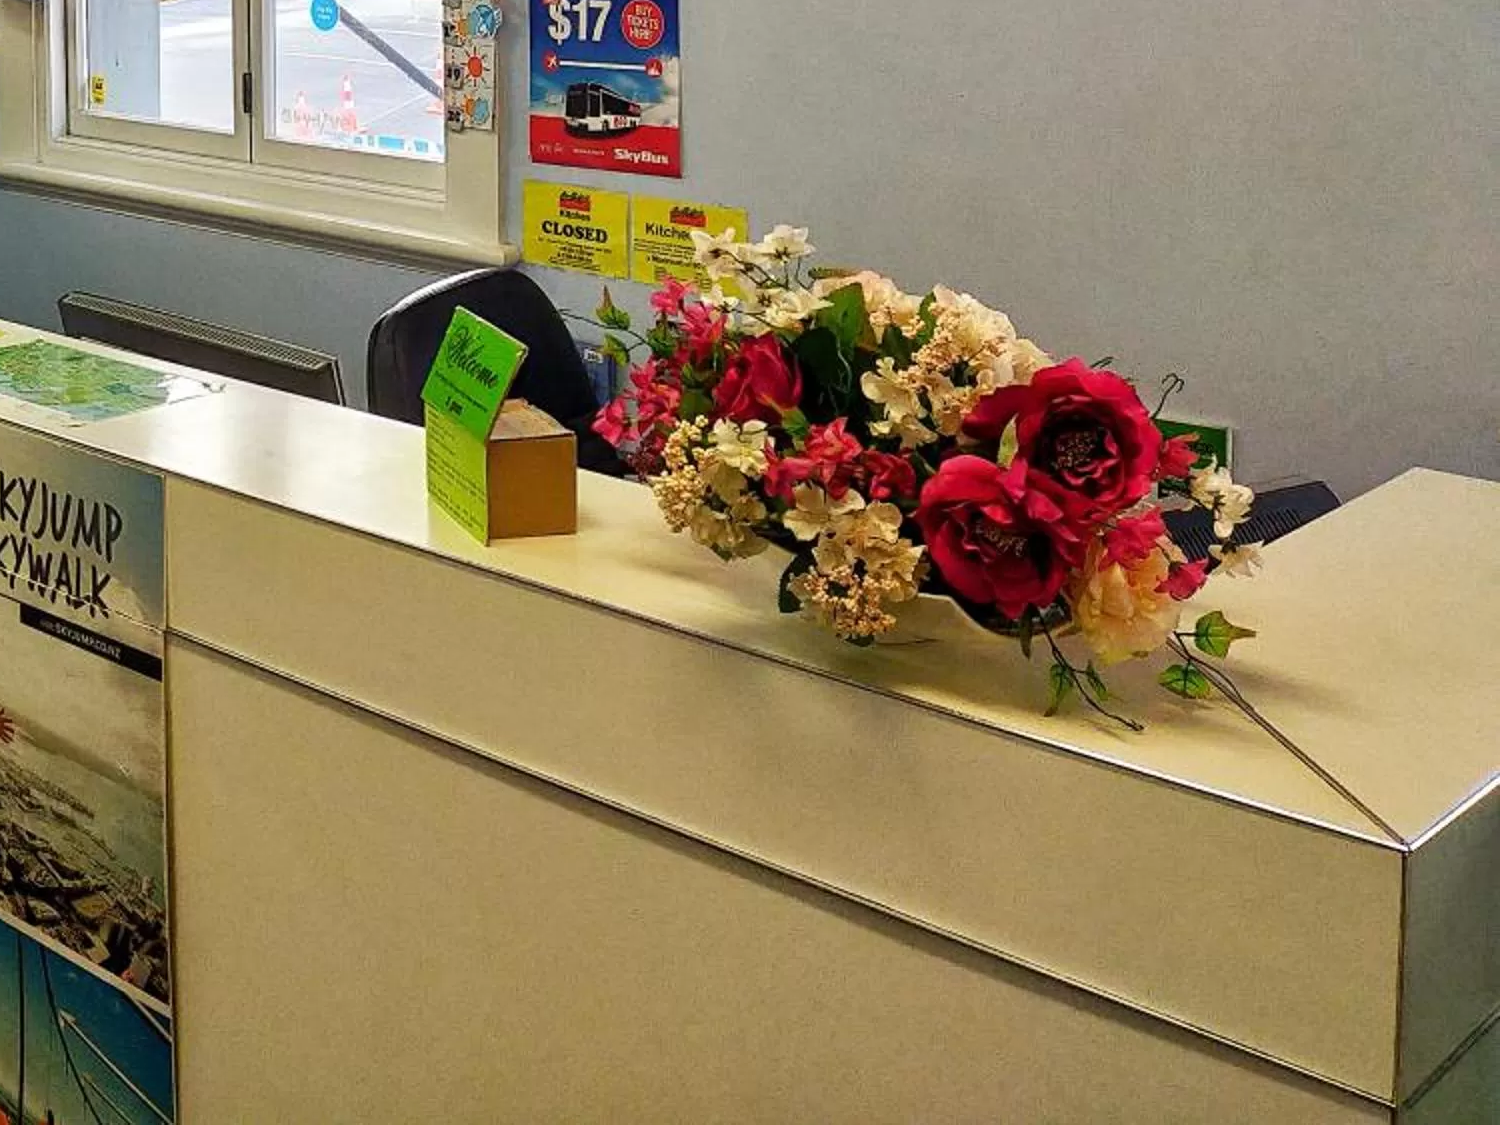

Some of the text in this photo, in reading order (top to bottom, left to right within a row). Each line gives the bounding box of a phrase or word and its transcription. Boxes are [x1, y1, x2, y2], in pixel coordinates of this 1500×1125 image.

[635, 3, 653, 17] BUY
[627, 14, 661, 31] TICKETS
[612, 147, 670, 165] SkyBus
[541, 220, 608, 244] CLOSED
